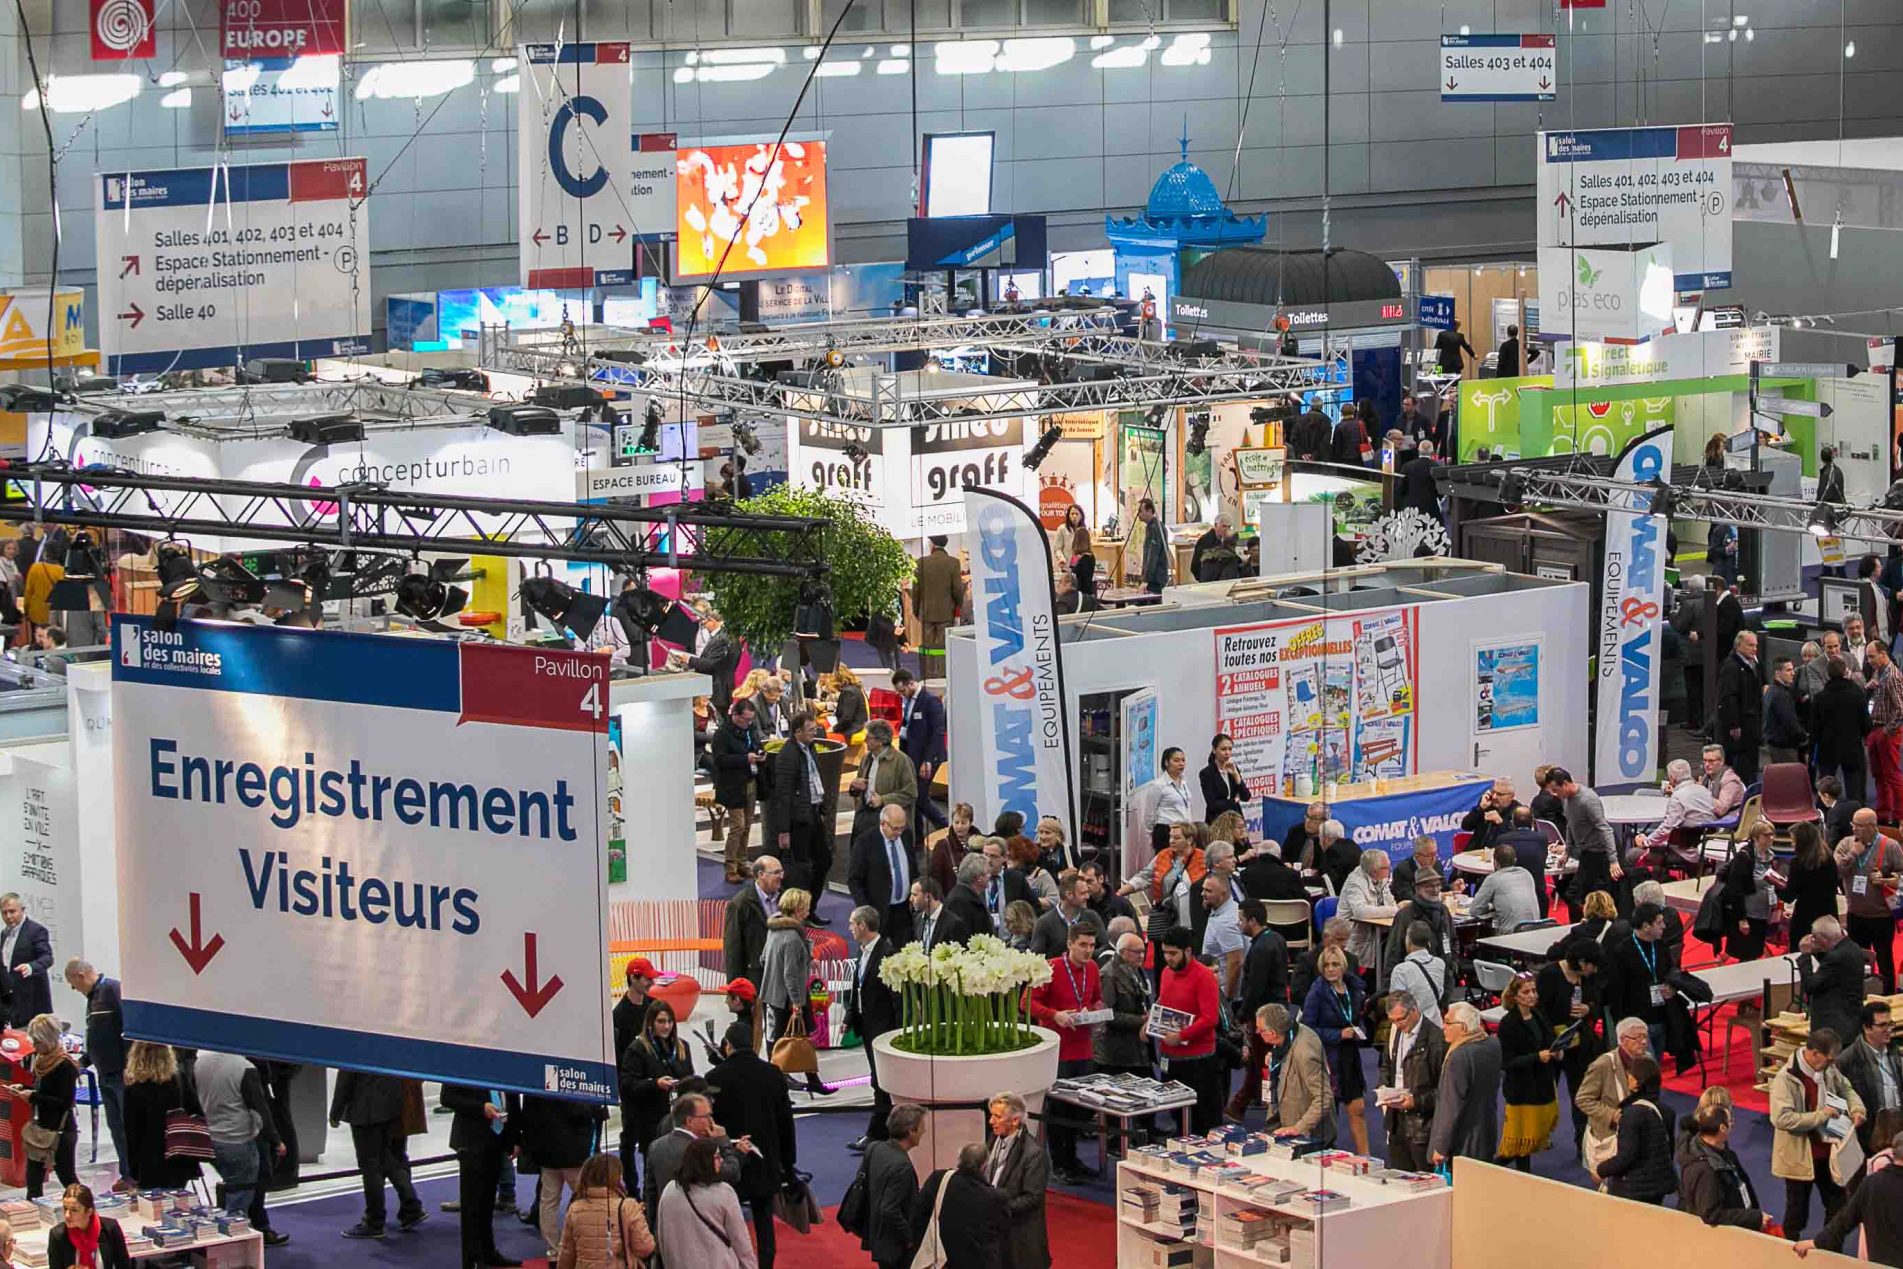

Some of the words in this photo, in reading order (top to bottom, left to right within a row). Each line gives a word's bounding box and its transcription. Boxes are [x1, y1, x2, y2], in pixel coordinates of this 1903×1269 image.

[226, 29, 307, 48] EUROPE
[1548, 38, 1554, 46] 4
[618, 49, 628, 62] 4
[1446, 55, 1484, 69] Salles
[1487, 57, 1510, 70] 403
[1513, 56, 1526, 68] et
[1529, 57, 1552, 70] 404
[549, 95, 609, 198] C
[1558, 137, 1576, 145] salon
[1558, 144, 1570, 152] des
[1718, 136, 1728, 152] 4
[323, 161, 362, 172] Pavillon
[350, 172, 362, 192] 4
[1580, 175, 1612, 189] Salles
[1614, 174, 1635, 189] 401,
[1661, 172, 1680, 186] 403
[1683, 172, 1692, 183] et
[1695, 171, 1714, 185] 404
[1580, 195, 1619, 211] Espace
[1621, 190, 1697, 207] Stationnement
[1580, 211, 1658, 229] dépénalisation
[155, 230, 200, 249] Salles
[236, 228, 266, 244] 402,
[270, 226, 296, 242] 403
[299, 225, 315, 238] et
[317, 222, 344, 238] 404
[557, 226, 569, 245] B
[589, 224, 601, 243] D
[155, 254, 209, 275] Espace
[212, 247, 320, 268] Stationnement
[765, 298, 792, 309] SERVICE
[805, 297, 814, 305] LA
[1558, 291, 1588, 311] plas
[1594, 297, 1621, 310] eco
[157, 304, 194, 321] Salle
[198, 305, 216, 320] 40
[1175, 304, 1208, 318] Toilettes
[1288, 312, 1329, 325] Toilettes
[1595, 344, 1630, 361] irect
[1744, 349, 1772, 361] MAIRIE
[338, 452, 511, 488] concepturbain
[928, 451, 1009, 501] graff
[593, 476, 634, 490] ESPACE
[636, 473, 676, 486] BUREAU
[911, 515, 923, 528] LE
[978, 504, 1025, 665] VALCO
[1602, 551, 1622, 678] EQUIPEMENTS
[1620, 596, 1660, 629] &
[143, 630, 183, 646] salon
[1224, 636, 1276, 652] Retrouvez
[1288, 623, 1325, 651] OFFRES
[143, 644, 168, 661] des
[173, 648, 222, 667] maires
[1224, 652, 1257, 667] toutes
[1260, 650, 1277, 664] nos
[1279, 640, 1353, 661] EXCEPTIONNELLES
[143, 661, 151, 669] et
[151, 661, 163, 670] des
[164, 662, 199, 673] collectivités
[200, 665, 222, 675] locales
[534, 656, 603, 681] Pavillon
[983, 665, 1037, 699] &
[1033, 613, 1059, 749] EQUIPEMENTS
[1221, 677, 1231, 695] 2
[1233, 670, 1278, 685] CATALOGUES
[1233, 679, 1266, 692] ANNUELS
[579, 683, 603, 720] 4
[1618, 629, 1652, 778] VALCO
[1233, 713, 1279, 727] CATALOGUES
[994, 704, 1039, 840] OMAT
[149, 737, 578, 842] Enregistrement
[1353, 819, 1408, 844] COMAT
[1408, 816, 1420, 840] &
[239, 847, 481, 936] Visiteurs
[560, 1068, 586, 1080] salon
[560, 1077, 576, 1090] des
[579, 1081, 611, 1094] maires
